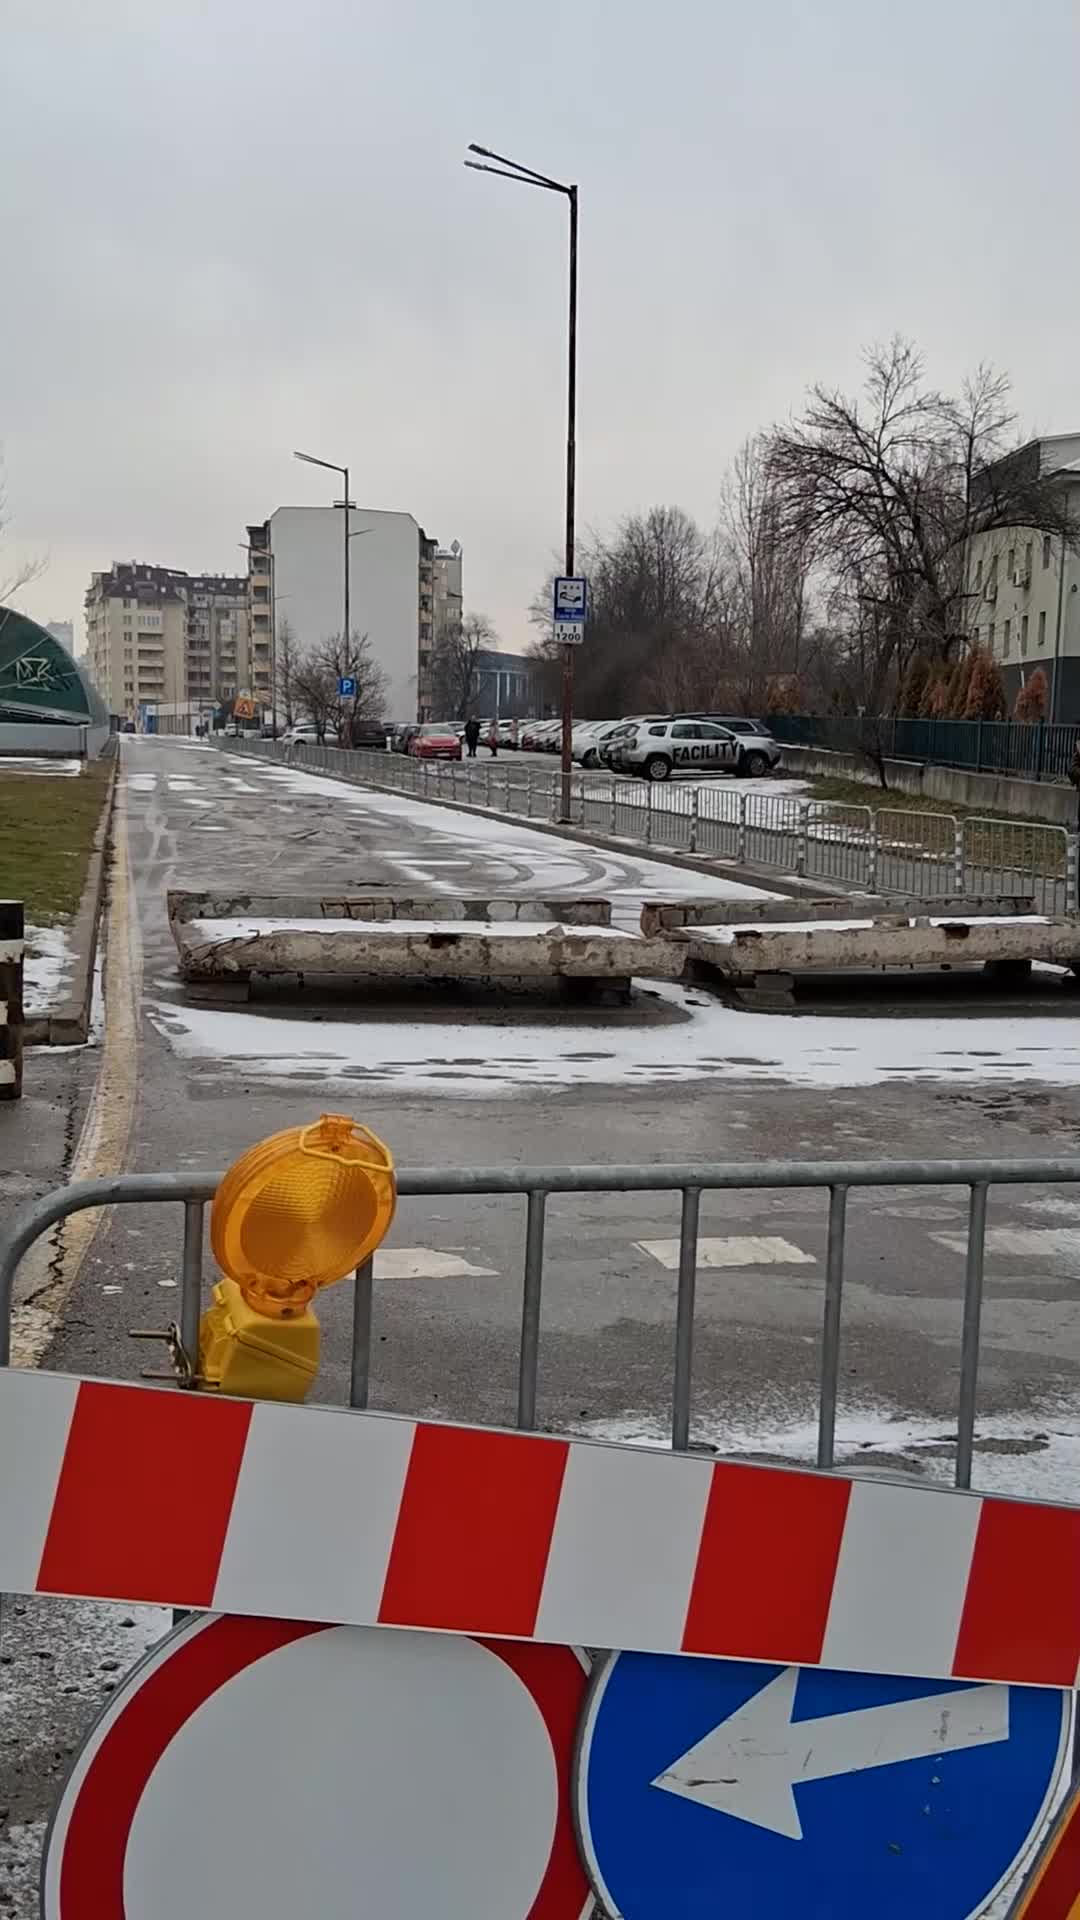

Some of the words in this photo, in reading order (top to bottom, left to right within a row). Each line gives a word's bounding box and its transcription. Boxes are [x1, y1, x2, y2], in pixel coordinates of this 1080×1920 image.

[556, 632, 581, 641] 1200
[342, 679, 352, 693] P
[672, 741, 739, 762] FACILITY
